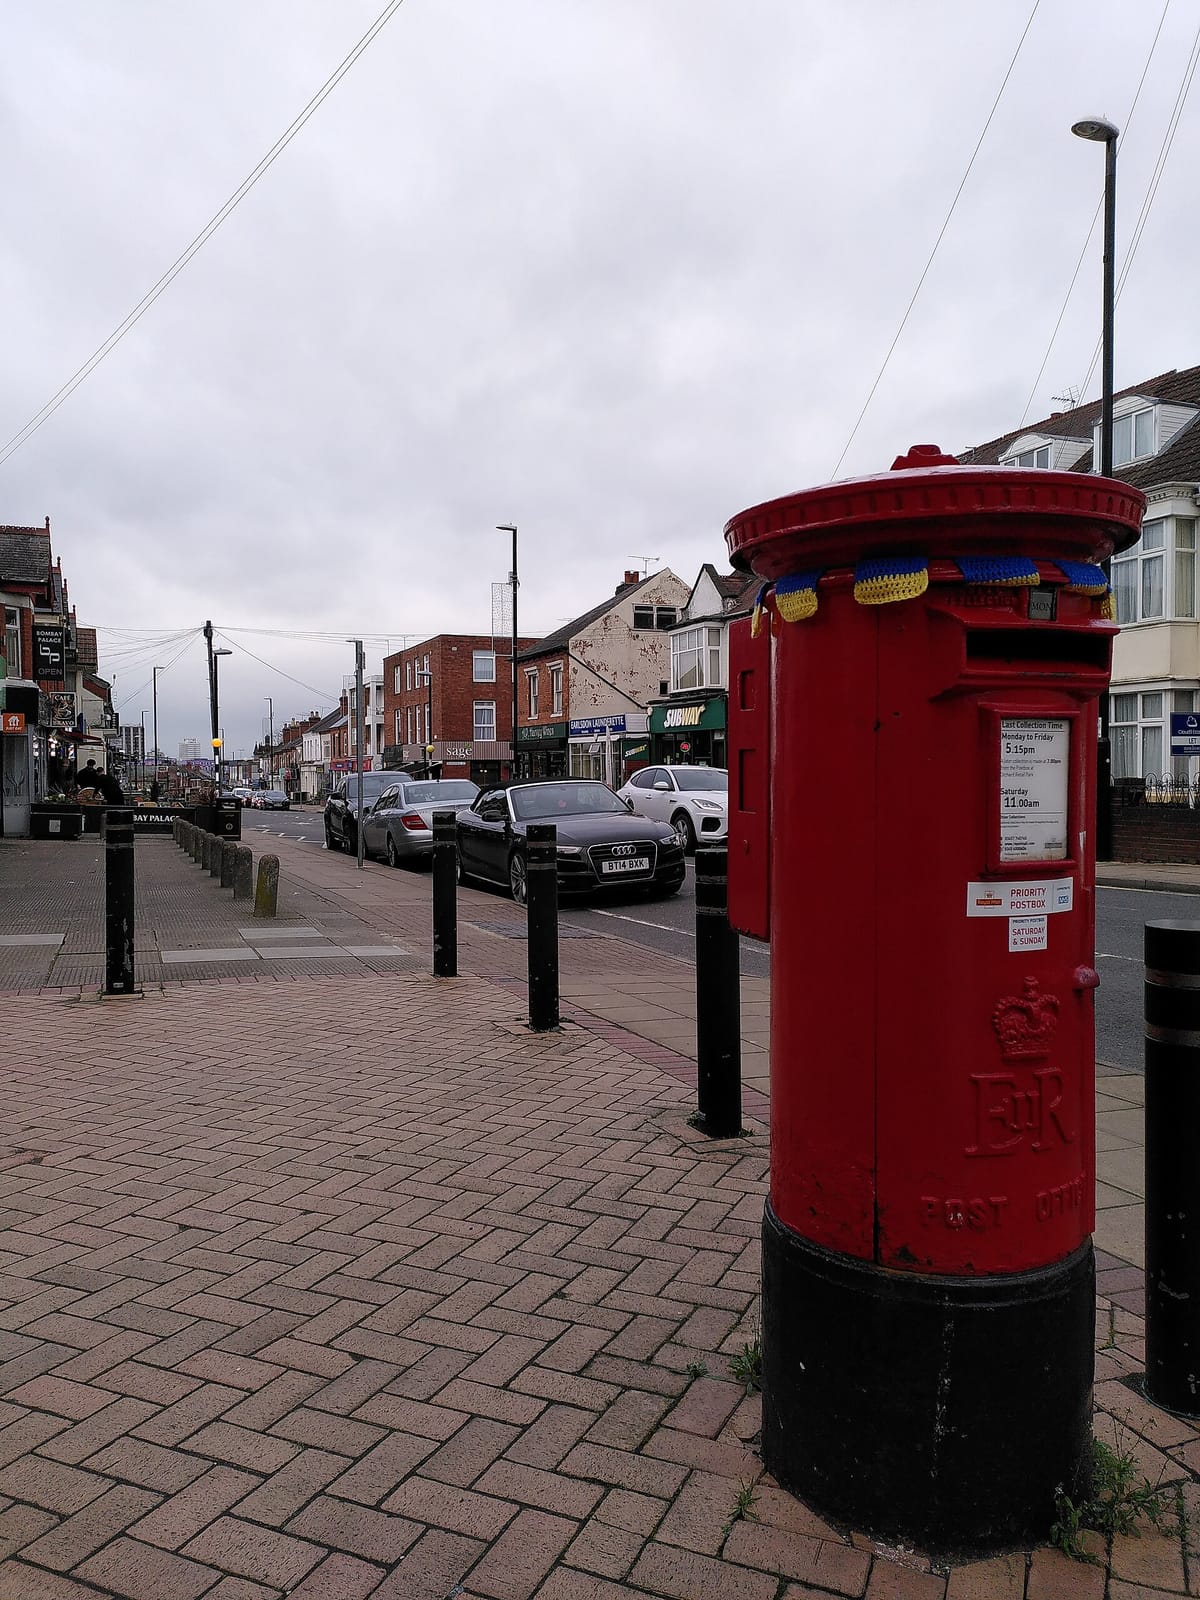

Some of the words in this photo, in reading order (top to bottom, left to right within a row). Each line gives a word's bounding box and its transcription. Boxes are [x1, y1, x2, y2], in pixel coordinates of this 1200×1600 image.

[1031, 601, 1053, 611] MON
[38, 667, 62, 676] OPEN
[663, 705, 705, 728] SUBWAY
[570, 719, 592, 729] EARLSDON
[592, 715, 625, 728] LAUNDERETTE
[1002, 721, 1015, 729] Last
[1016, 721, 1046, 729] Collection
[1048, 721, 1063, 729] Time
[1002, 733, 1025, 741] Monday
[1026, 733, 1034, 741] to
[1034, 733, 1054, 742] Friday
[446, 747, 473, 759] sage
[1005, 742, 1036, 755] 5.15pm
[1001, 788, 1029, 796] Saturday
[1004, 796, 1040, 808] 11.00am
[608, 860, 626, 870] BT14
[628, 860, 645, 869] BXK
[1010, 888, 1047, 897] PRIORITY
[1010, 900, 1046, 910] POSTBOX
[1012, 926, 1046, 936] SATURDAY
[1020, 936, 1045, 945] SUNDAY
